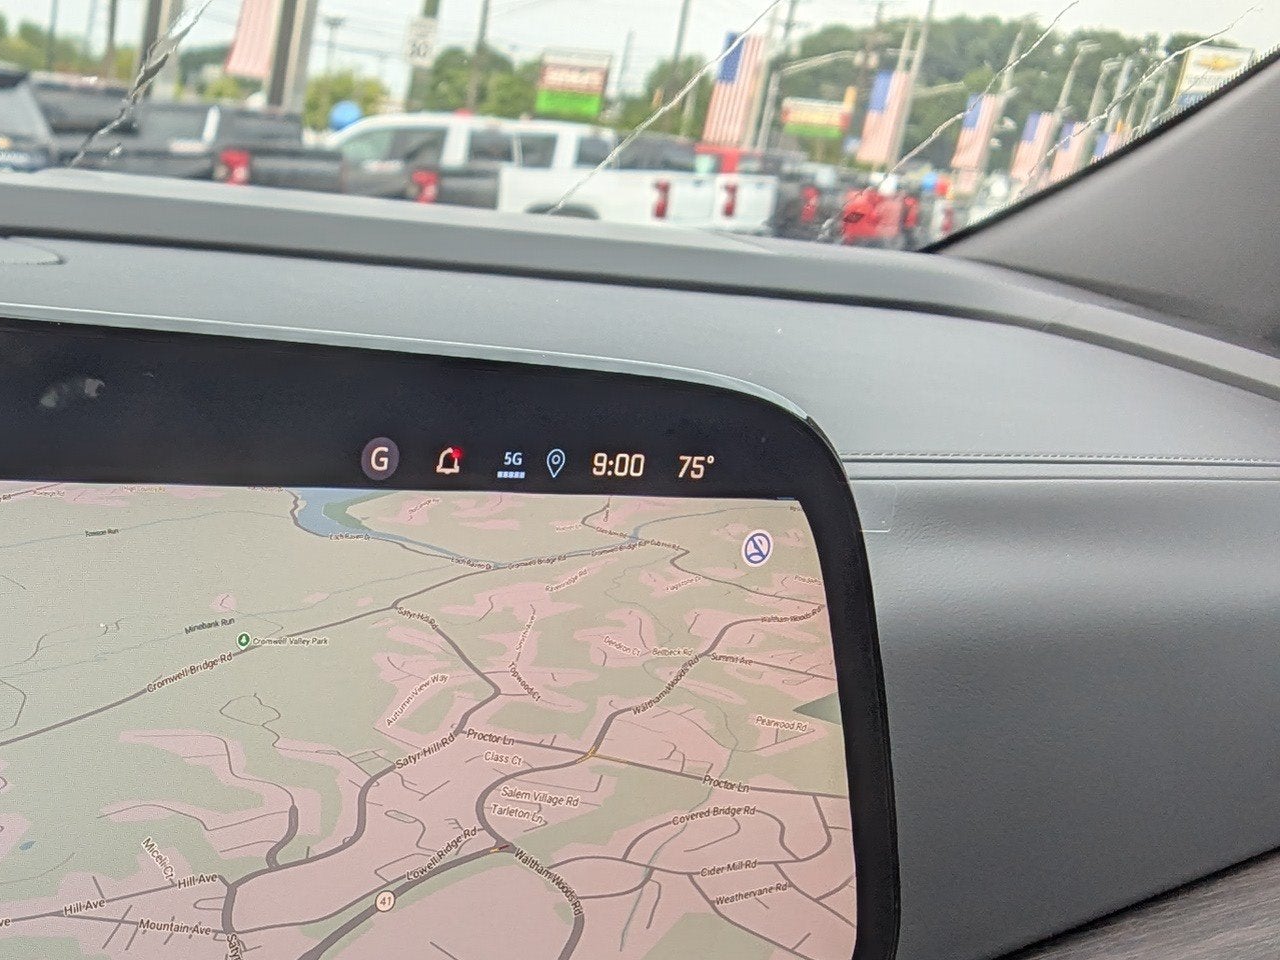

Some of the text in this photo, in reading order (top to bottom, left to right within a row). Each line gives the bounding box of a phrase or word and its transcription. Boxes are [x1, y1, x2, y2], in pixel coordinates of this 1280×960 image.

[370, 446, 388, 472] G
[503, 451, 523, 466] 5G
[592, 452, 645, 477] 9:00
[678, 454, 715, 479] 75°
[185, 617, 235, 634] Minebank Run
[252, 637, 328, 646] Cromwell Valley Park
[146, 652, 233, 693] Cromwell Bridge Rd
[508, 661, 533, 694] Topwood
[632, 657, 700, 715] Waltham Woods Rd
[386, 674, 448, 726] Autumn View Way
[755, 715, 807, 732] Pearwood Rd
[467, 728, 515, 746] Proctor Ln
[396, 733, 455, 770] Satyr Hill Rd
[484, 751, 522, 766] Class Ct
[703, 774, 750, 793] Proctor Ln
[501, 786, 579, 807] Salem Village Rd
[490, 804, 543, 823] Tarleton Ln
[672, 805, 756, 826] Covered Bridge Rd
[142, 837, 167, 872] Miceli
[406, 827, 477, 880] Lowell Ridge Rd
[700, 859, 758, 877] Cider Mill Rd
[177, 873, 218, 889] Hill Ave
[515, 847, 583, 920] Waltham Woods Rd
[379, 896, 392, 906] 41
[715, 881, 788, 905] Weathervane Rd
[63, 898, 106, 916] Hill Ave
[139, 918, 212, 936] Mountain Ave
